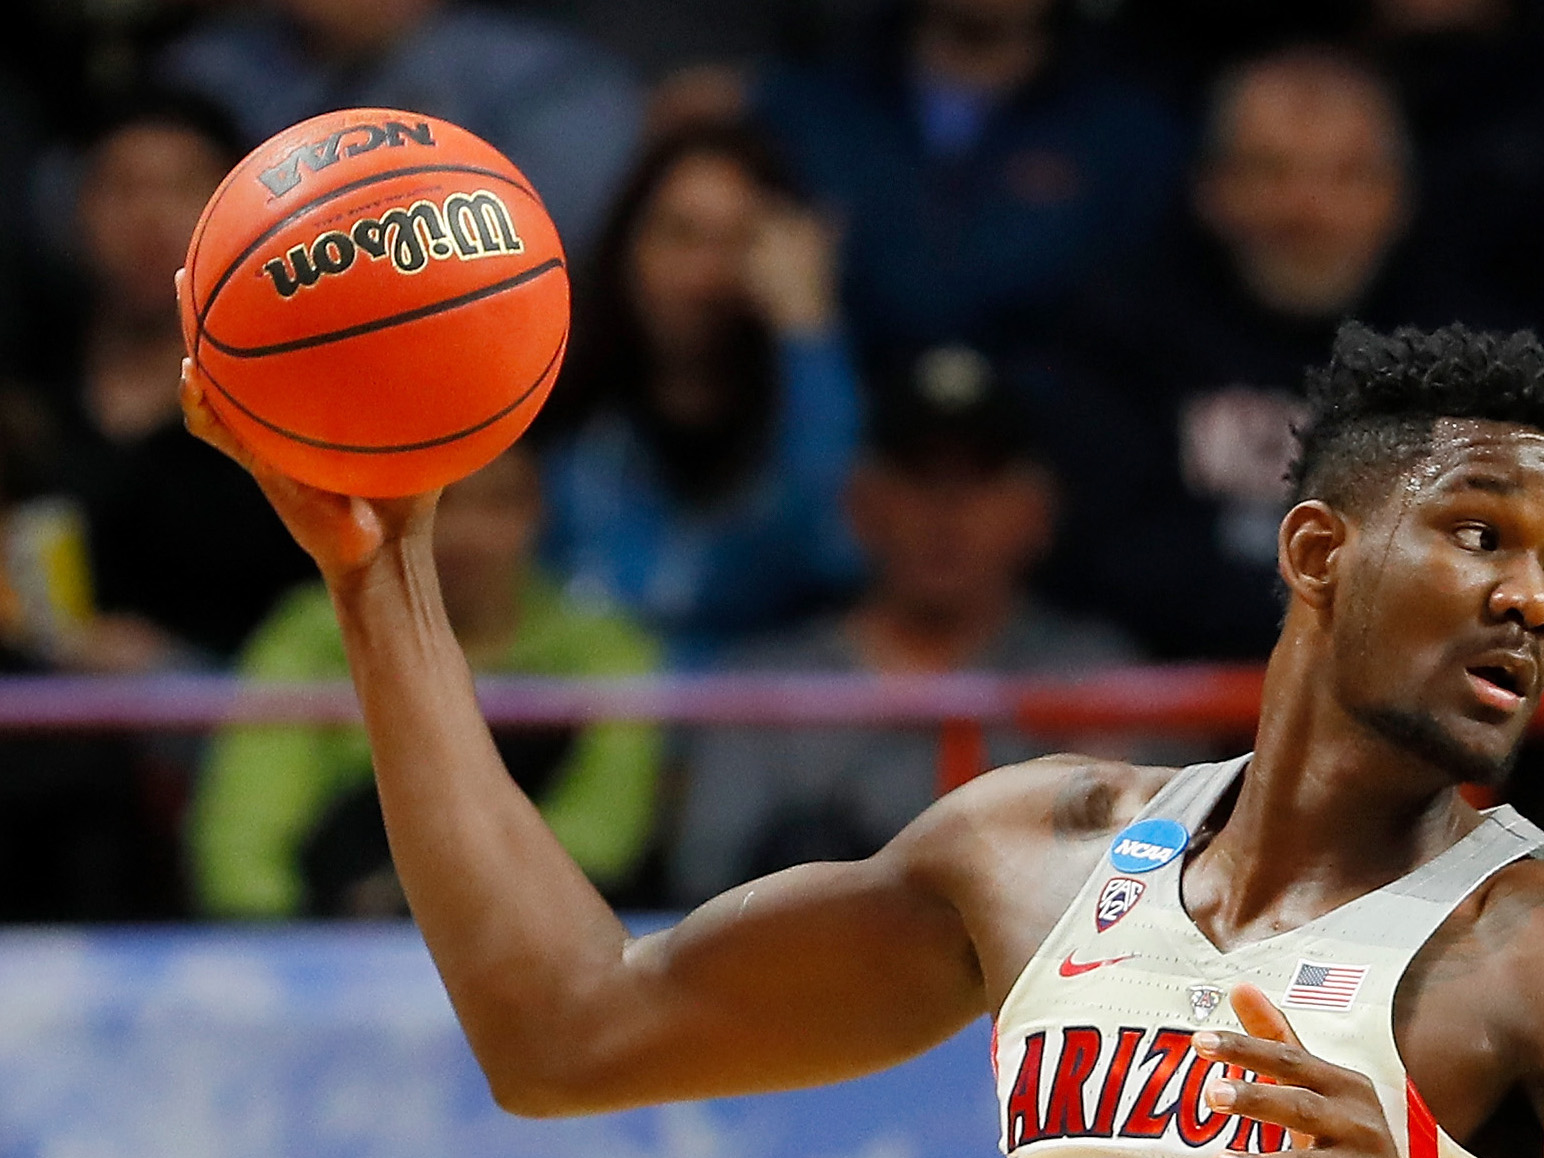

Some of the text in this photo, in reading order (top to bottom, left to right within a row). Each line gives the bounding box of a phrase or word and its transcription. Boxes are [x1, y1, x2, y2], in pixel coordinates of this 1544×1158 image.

[257, 121, 435, 196] NCAA
[264, 189, 523, 298] Wilson
[1113, 838, 1176, 862] NCAA
[1098, 899, 1124, 921] 12
[1101, 878, 1145, 912] PAC
[1007, 1025, 1292, 1154] ARIZO
